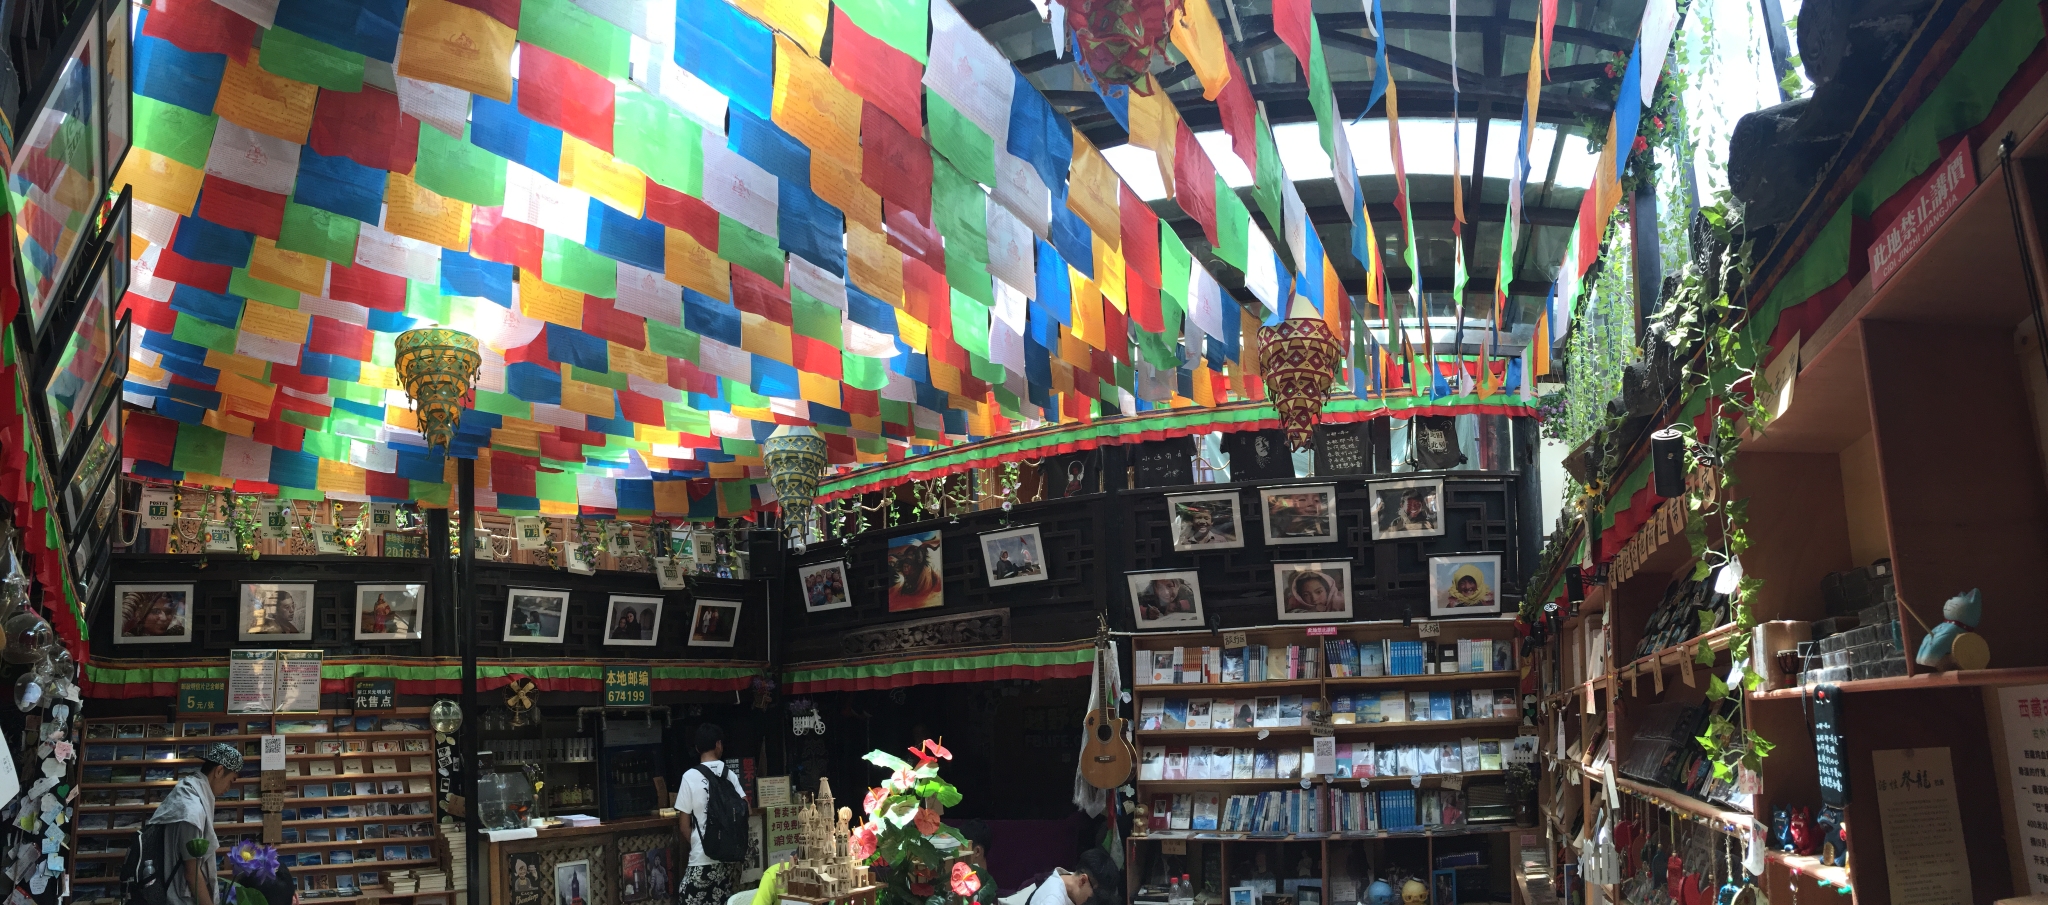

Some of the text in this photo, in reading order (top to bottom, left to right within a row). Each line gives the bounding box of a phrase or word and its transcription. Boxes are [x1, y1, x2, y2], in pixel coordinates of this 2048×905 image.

[1872, 151, 1966, 273] 此地禁止講價
[1883, 195, 1958, 277] CIDI JINZHI JIANGJIA
[151, 506, 167, 516] 1月
[375, 515, 390, 523] 5月
[526, 529, 540, 537] 7月
[606, 670, 649, 687] 本地邮编
[356, 695, 392, 708] 代售点
[608, 690, 645, 702] 674199
